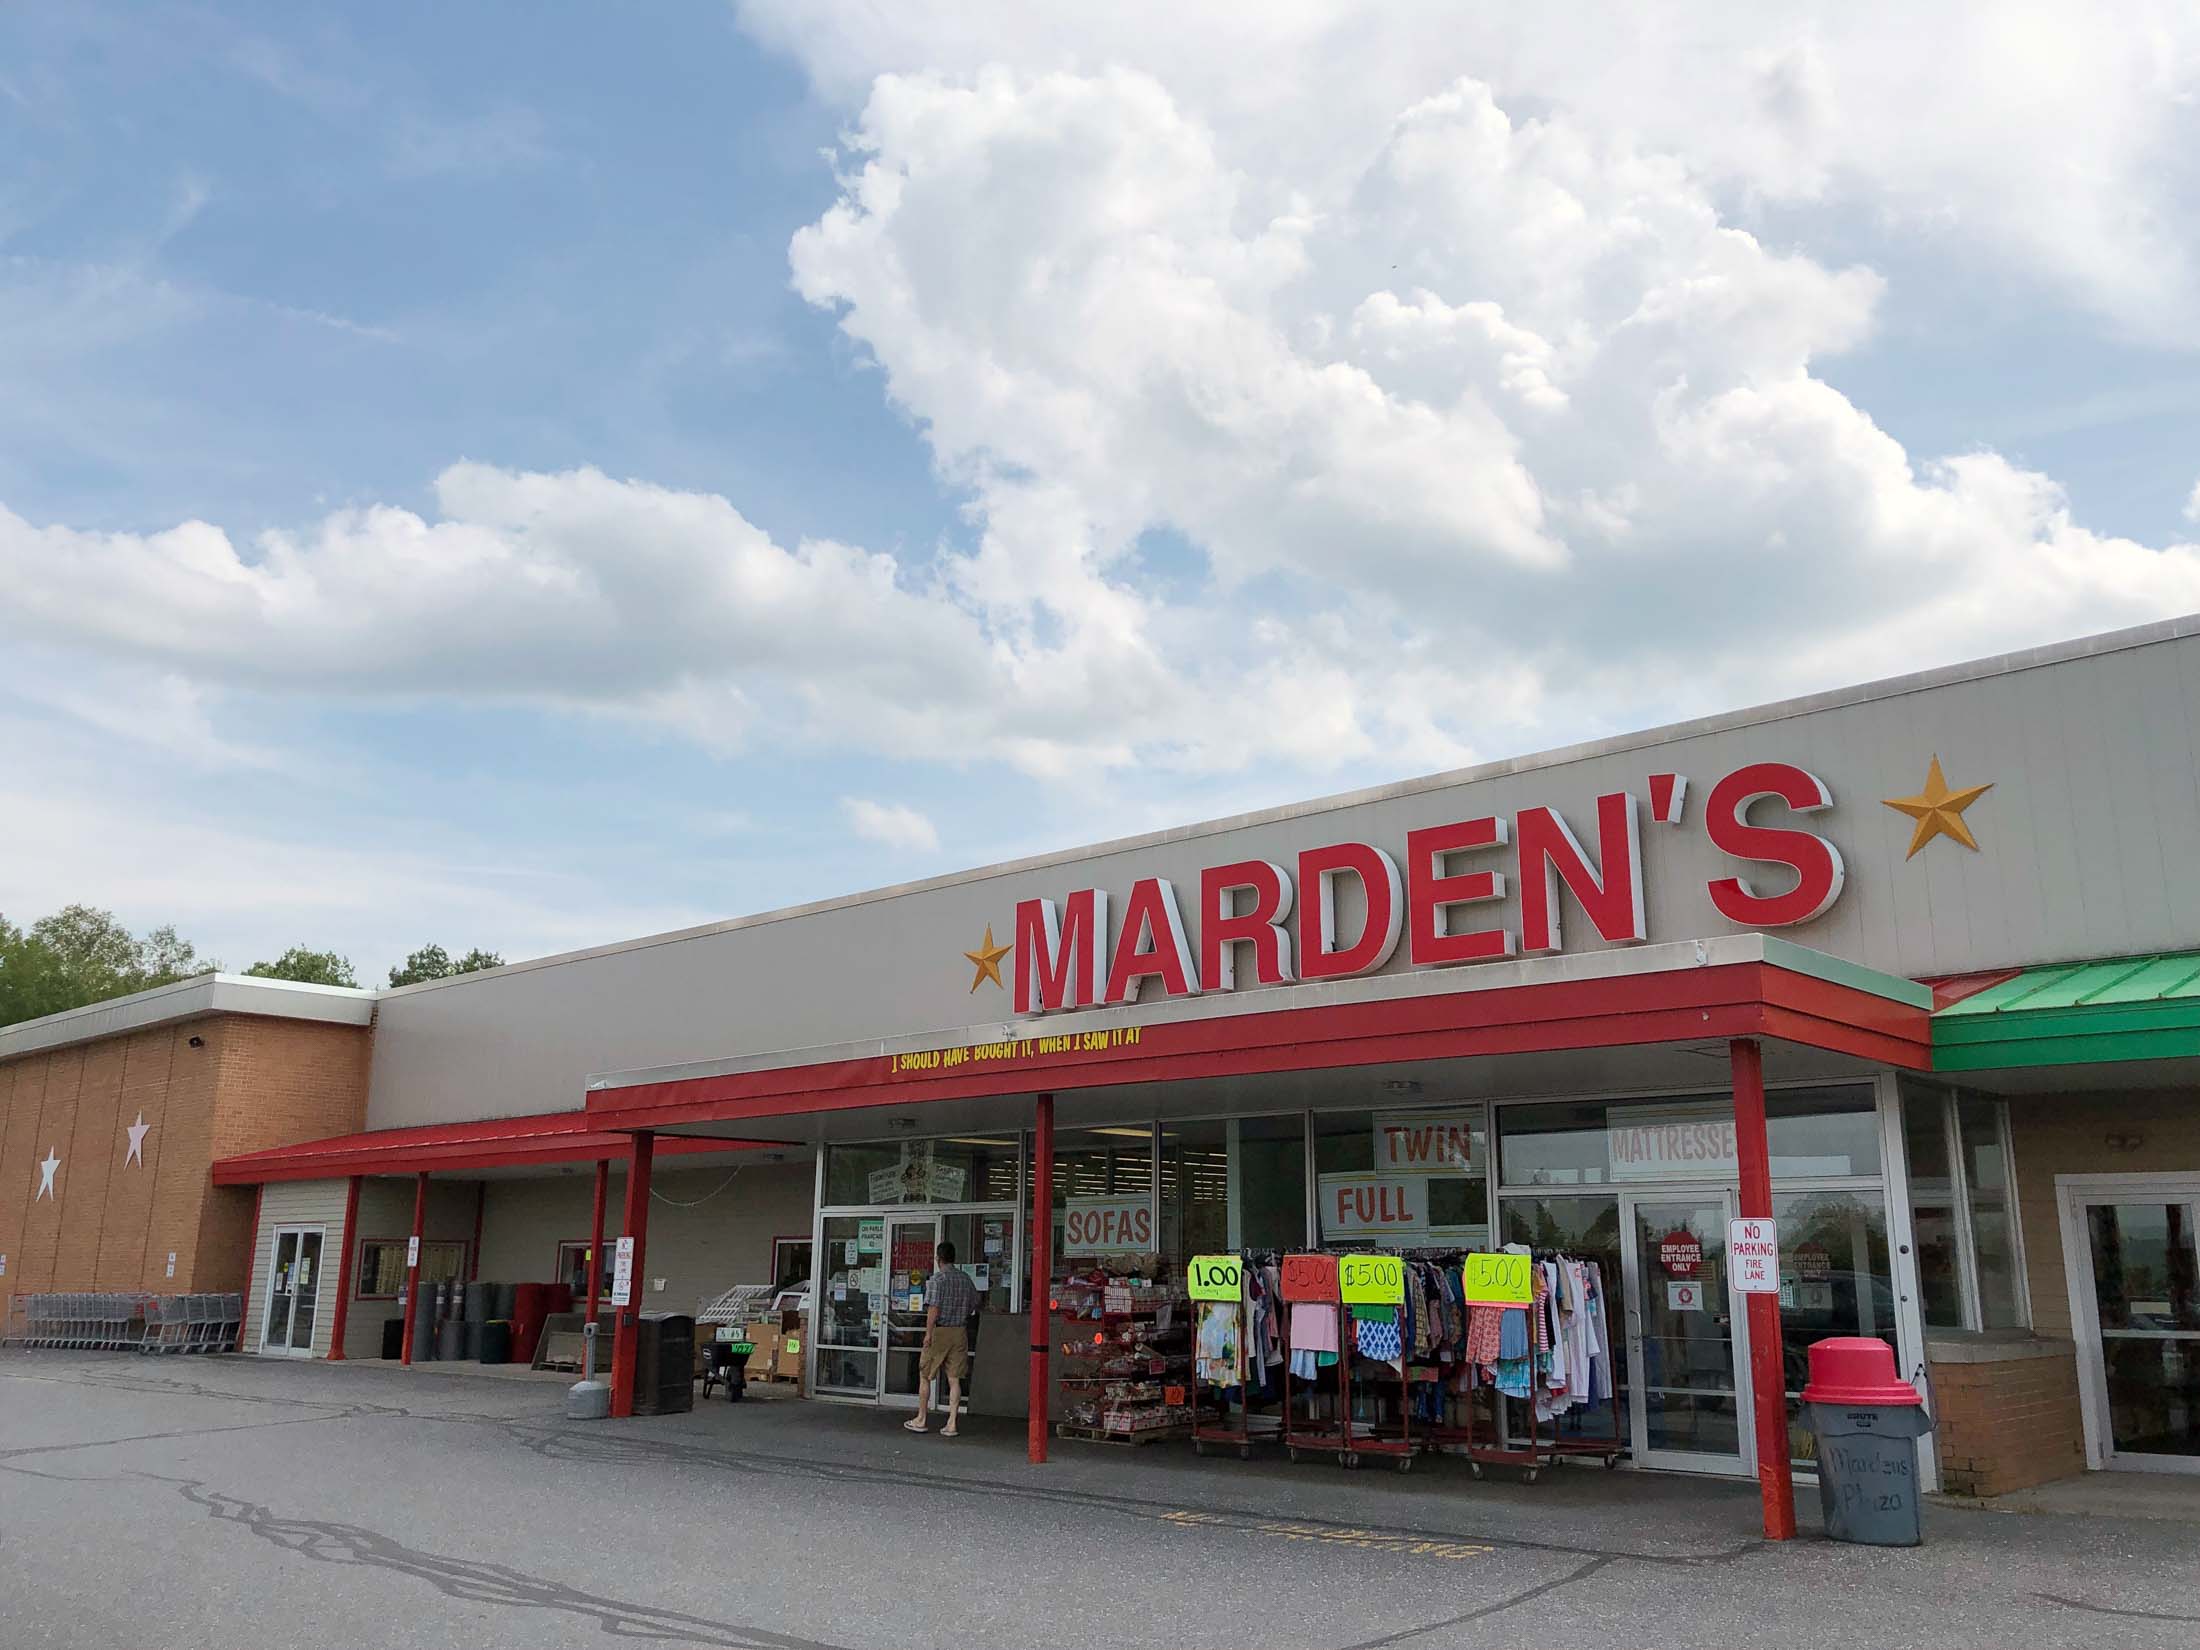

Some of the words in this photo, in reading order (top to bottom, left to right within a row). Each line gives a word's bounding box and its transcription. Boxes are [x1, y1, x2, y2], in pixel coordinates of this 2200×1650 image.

[1013, 761, 1845, 1014] MARDEN'S
[891, 1056, 898, 1073] I
[901, 1051, 940, 1070] SHOULD
[943, 1047, 970, 1068] HAVE
[974, 1040, 1018, 1061] BOUGHT
[1021, 1039, 1034, 1058] IT,
[1039, 1034, 1070, 1054] WHEN
[1073, 1033, 1081, 1051] I
[1084, 1030, 1109, 1050] SAW
[1112, 1028, 1123, 1046] IT
[1125, 1026, 1142, 1045] AT
[1612, 1123, 1738, 1163] MATTRESSE
[1337, 1185, 1413, 1224] FULL
[1067, 1208, 1152, 1245] SOFAS
[1744, 1225, 1760, 1239] NO
[1660, 1253, 1702, 1263] ENTRANCE
[1661, 1244, 1700, 1254] EMPLOYEE
[1733, 1242, 1774, 1256] PARKING
[1672, 1262, 1692, 1272] ONLY
[1745, 1259, 1763, 1269] FIRE
[1195, 1263, 1239, 1287] 1.00
[1344, 1263, 1398, 1287] $5.00
[1744, 1271, 1765, 1280] LANE
